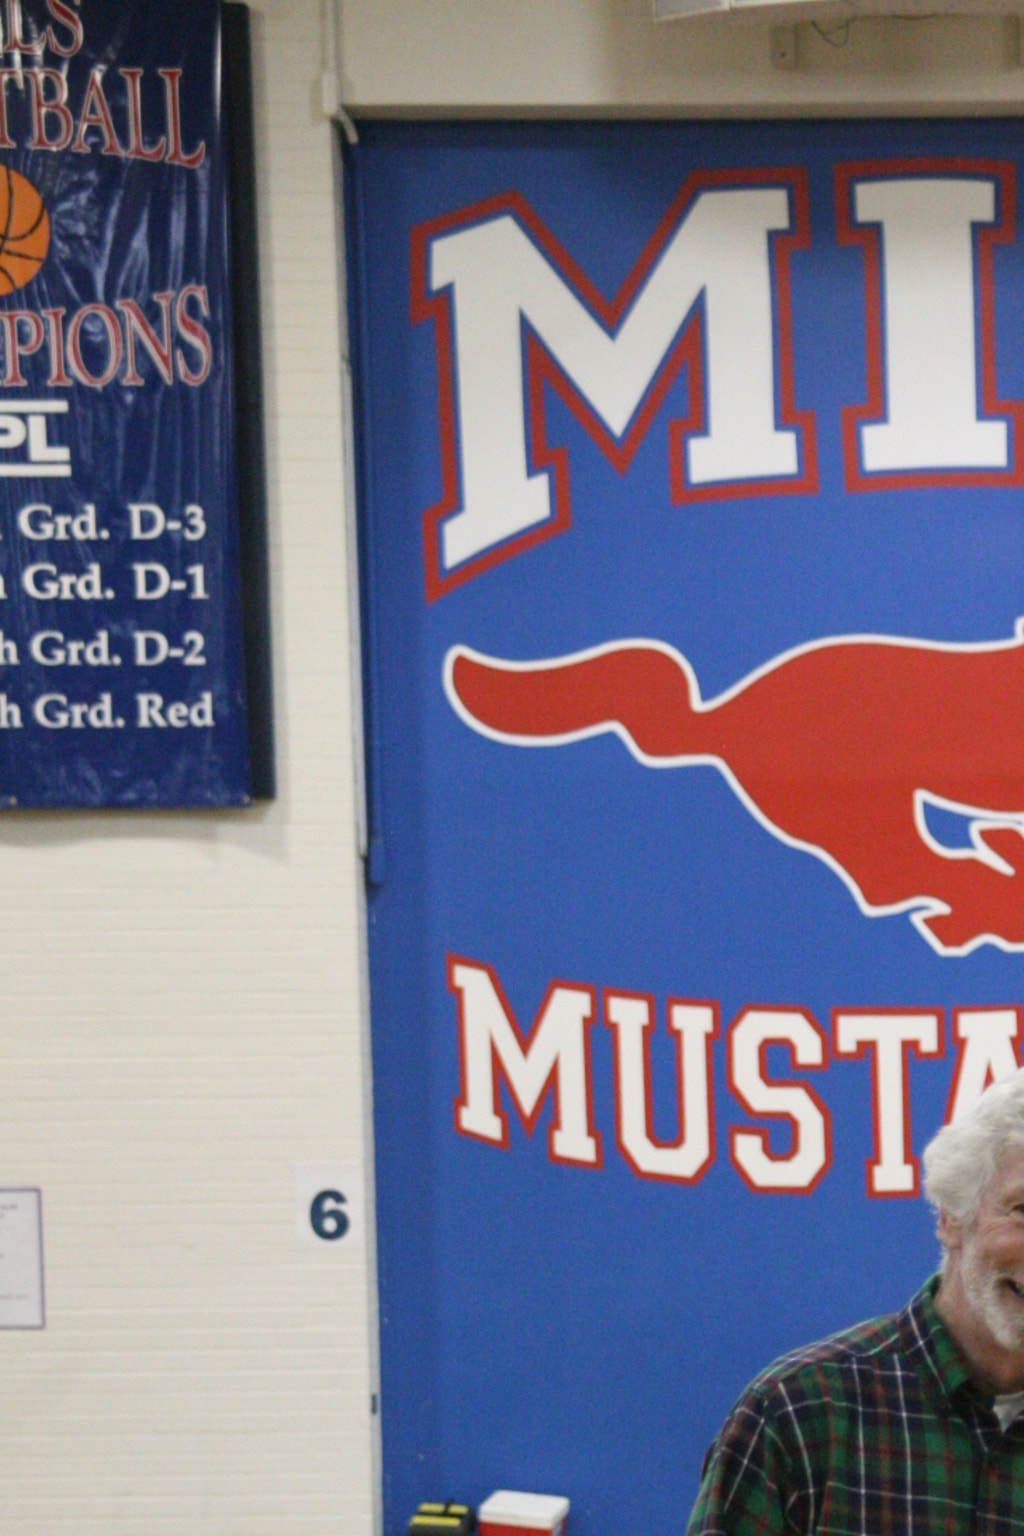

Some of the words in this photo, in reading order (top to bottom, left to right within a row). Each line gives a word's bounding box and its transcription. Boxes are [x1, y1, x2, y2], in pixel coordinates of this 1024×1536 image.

[18, 503, 110, 541] Grd.
[128, 503, 207, 541] D-3
[22, 562, 115, 600] Grd.
[133, 562, 209, 600] D-1
[30, 629, 122, 666] Grd.
[134, 630, 207, 666] D-2
[33, 692, 125, 729] Grd.
[136, 691, 216, 728] Red
[309, 1189, 350, 1241] 6
